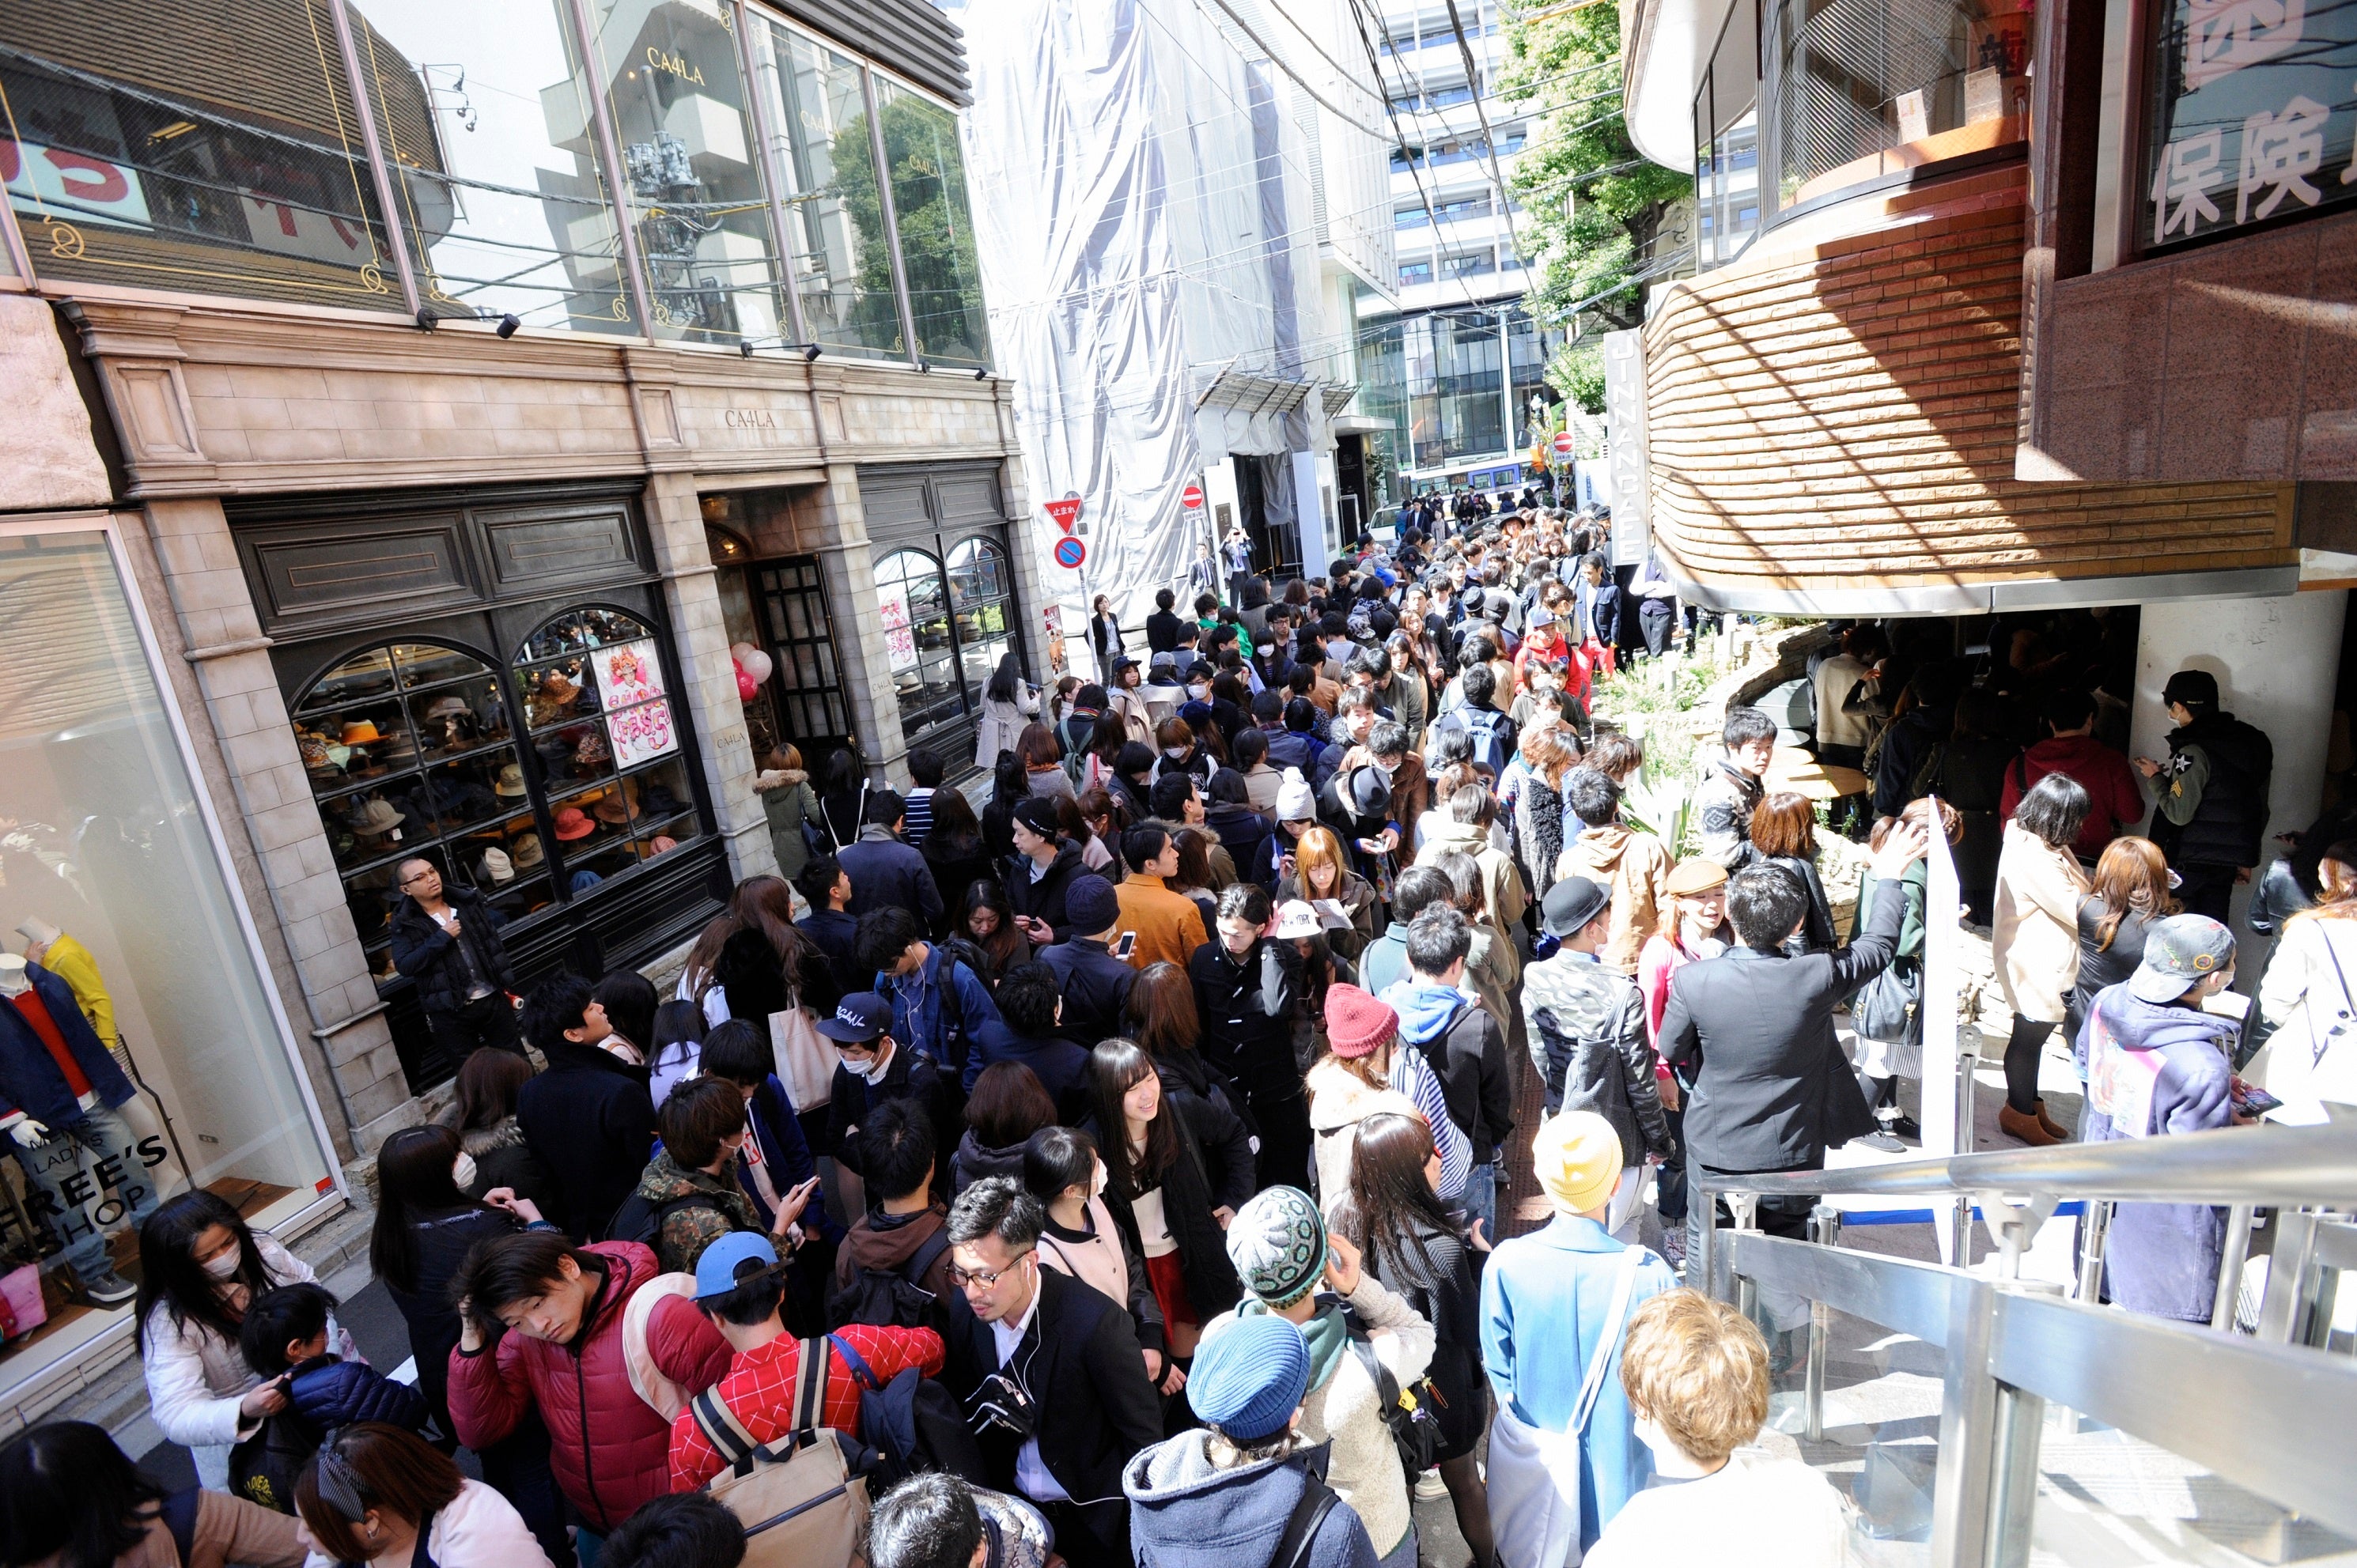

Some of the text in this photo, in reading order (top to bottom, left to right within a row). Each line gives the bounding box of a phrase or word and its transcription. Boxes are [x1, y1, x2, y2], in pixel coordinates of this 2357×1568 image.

[647, 46, 706, 87] CA4LA
[910, 155, 940, 179] CA4LA
[2151, 79, 2357, 244] 保険
[725, 410, 775, 428] CA4LA
[1053, 506, 1076, 516] 止まれ
[717, 732, 745, 749] CA4LA
[29, 1116, 92, 1152] MEN'S
[34, 1134, 103, 1174] LADY'S
